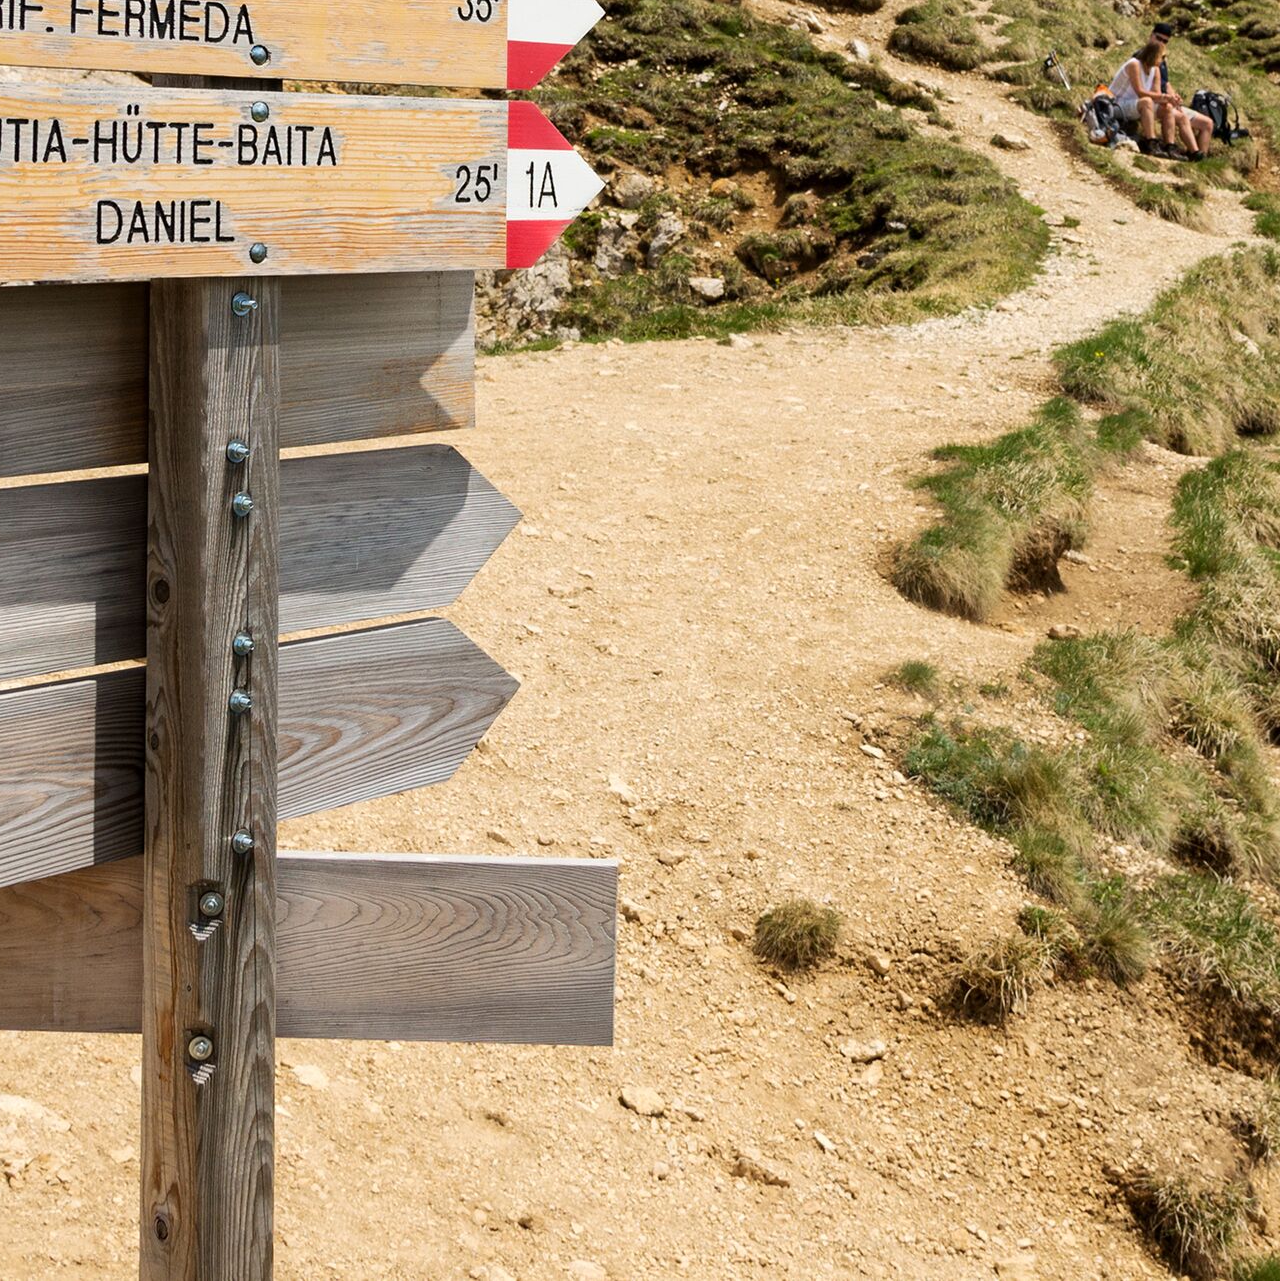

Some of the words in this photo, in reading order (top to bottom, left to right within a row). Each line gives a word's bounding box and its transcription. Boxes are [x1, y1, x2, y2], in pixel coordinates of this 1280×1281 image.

[454, 162, 498, 204] 25'
[525, 160, 559, 209] 1A
[95, 199, 236, 245] DANIEL
